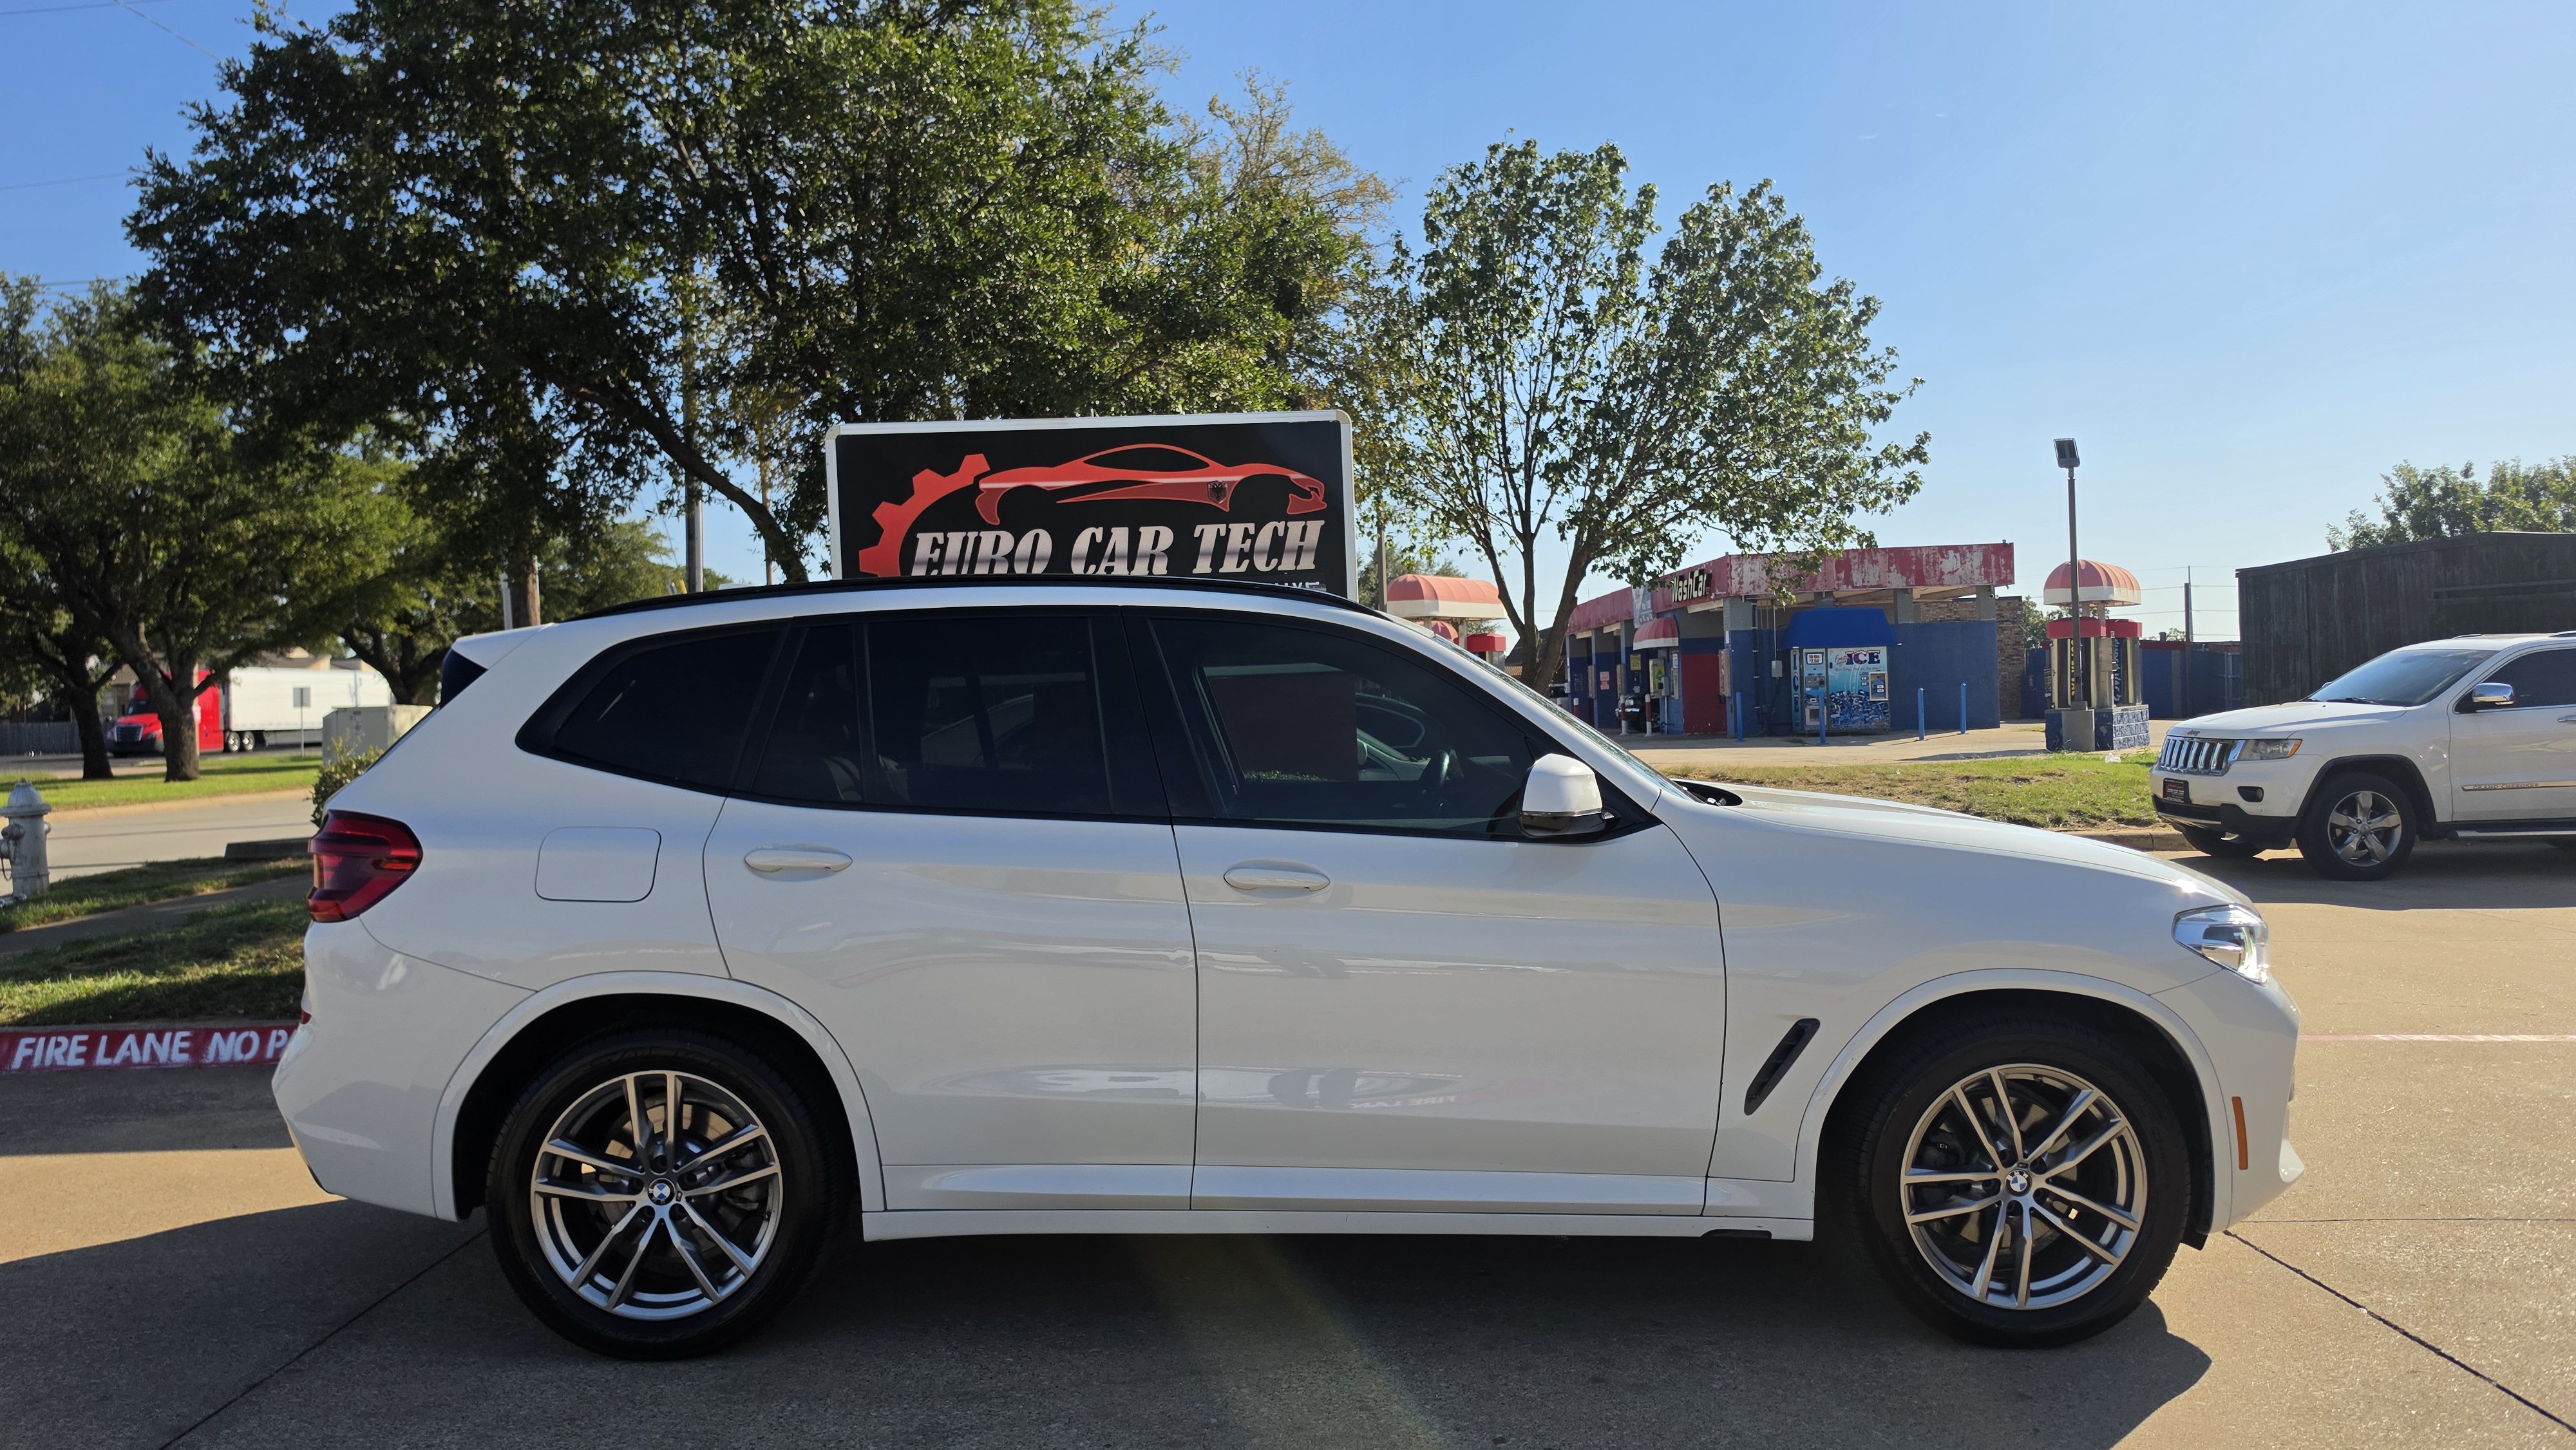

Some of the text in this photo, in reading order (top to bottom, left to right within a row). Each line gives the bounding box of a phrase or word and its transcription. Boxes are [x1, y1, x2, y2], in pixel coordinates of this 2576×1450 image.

[911, 520, 1325, 576] EURO CAR TECH
[1845, 650, 1880, 665] ICE
[11, 1035, 90, 1069] FIRE
[93, 1031, 194, 1066] LANE
[207, 1030, 260, 1064] NO
